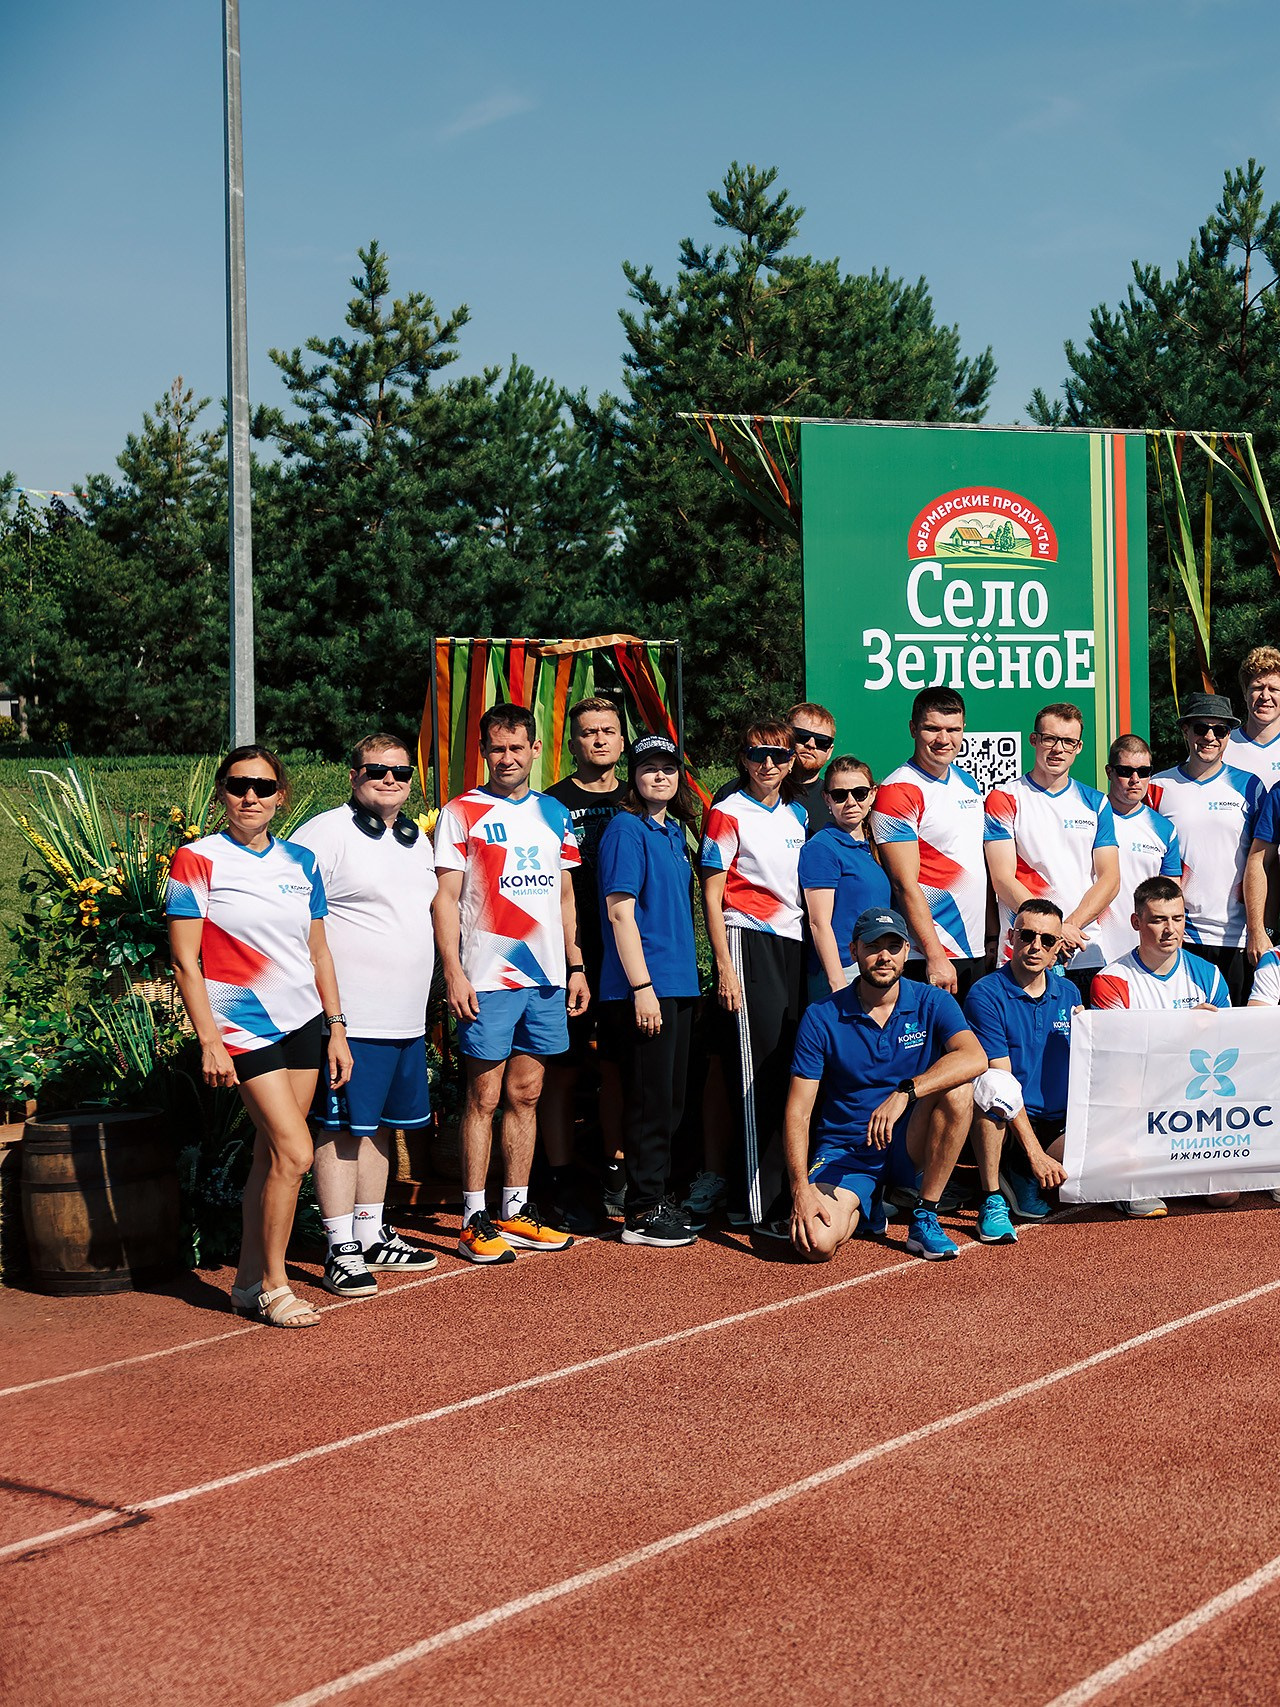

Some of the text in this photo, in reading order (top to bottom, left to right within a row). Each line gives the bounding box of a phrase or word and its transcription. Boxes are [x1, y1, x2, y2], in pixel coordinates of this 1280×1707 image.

[916, 494, 1050, 555] ФЕРМЕРСКИЕ ПРОДУКТЫ
[906, 561, 1049, 628] Село
[484, 823, 508, 844] 10
[500, 874, 554, 889] КОМОС
[512, 888, 550, 897] МИЛКОМ
[897, 1030, 927, 1044] КОМОС
[1147, 1105, 1274, 1135] КОМОС
[1170, 1133, 1251, 1150] МИЛКОМ
[1170, 1148, 1251, 1160] ИЖМОЛОКО
